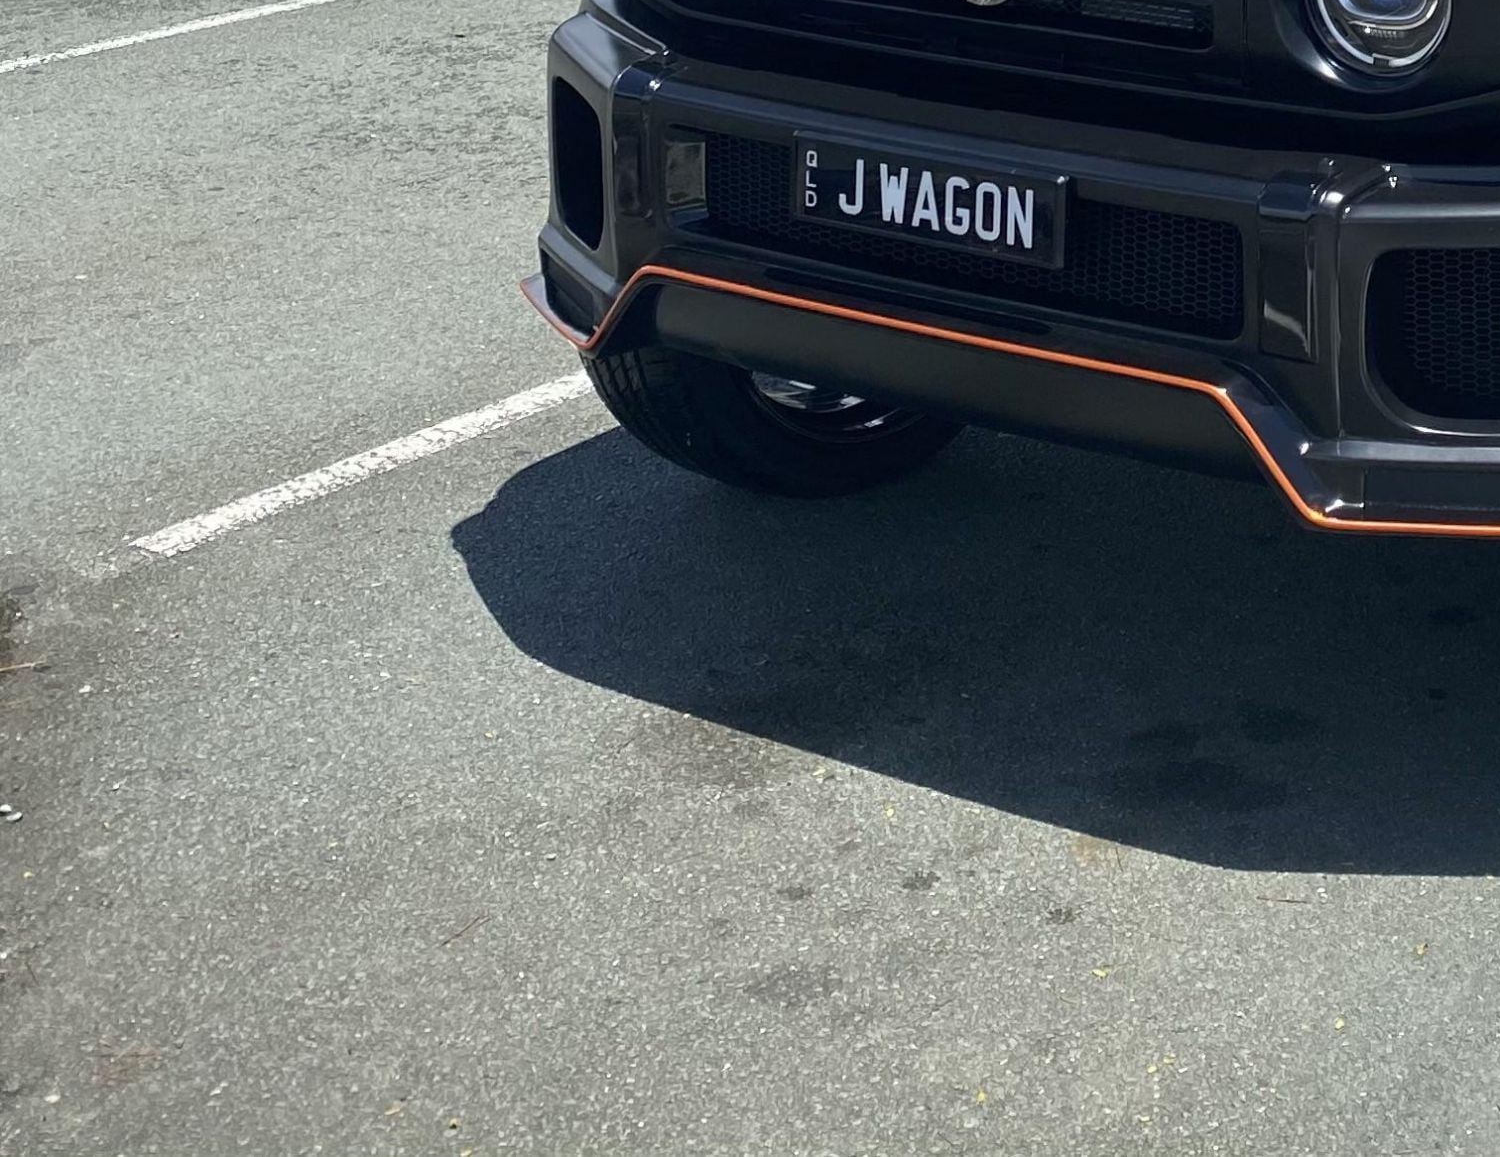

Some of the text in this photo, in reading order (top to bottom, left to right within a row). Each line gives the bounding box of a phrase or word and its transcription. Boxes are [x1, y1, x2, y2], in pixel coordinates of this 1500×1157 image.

[805, 150, 818, 207] QLD
[838, 159, 1035, 249] J WAGON
